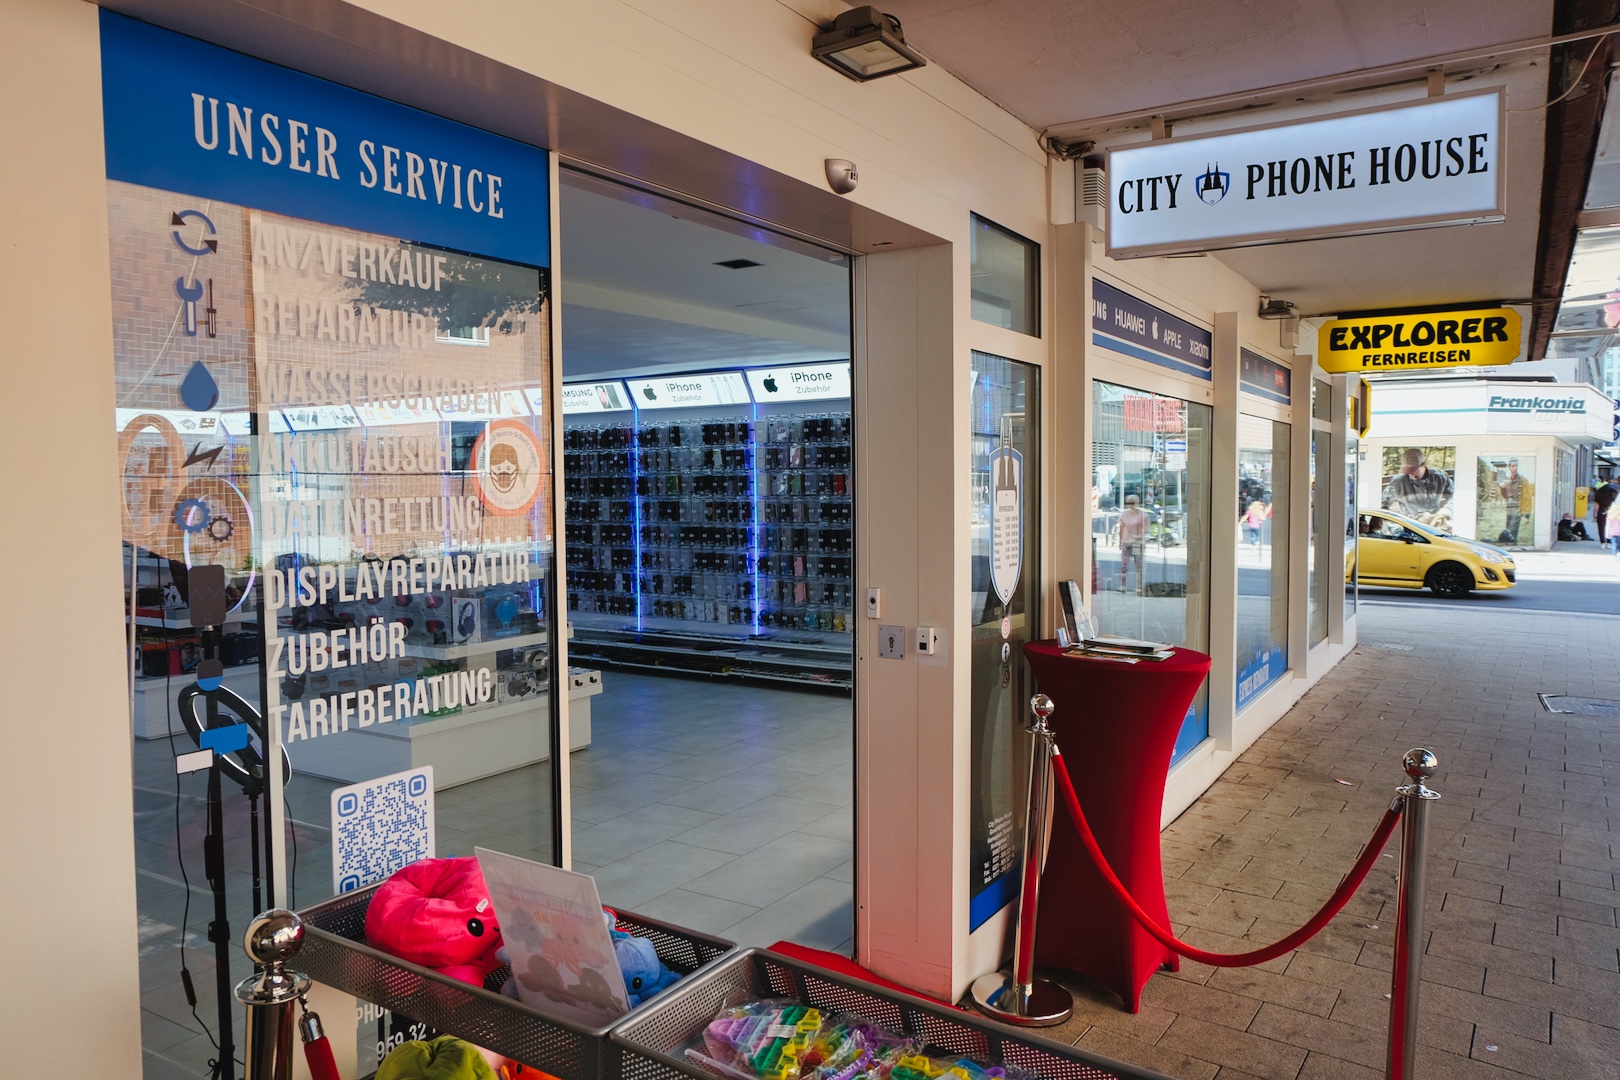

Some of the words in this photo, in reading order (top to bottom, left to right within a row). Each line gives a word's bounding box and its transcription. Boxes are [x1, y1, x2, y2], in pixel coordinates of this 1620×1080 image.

[191, 92, 341, 180] UNSER
[359, 139, 505, 219] SERVICE
[1118, 173, 1183, 215] CITY
[1246, 151, 1356, 200] PHONE
[1368, 133, 1489, 186] HOUSE
[252, 223, 447, 292] AN/VERKAUF
[256, 293, 428, 349] REPARATUR
[1114, 307, 1146, 336] HUAWEI
[1163, 328, 1182, 350] APPLE
[1329, 316, 1509, 352] EXPLORER
[790, 371, 833, 383] iPhone
[1362, 349, 1471, 367] FERNREISEN
[258, 362, 502, 415] WASSERSCHADEN
[562, 388, 593, 399] MSUNG
[665, 382, 702, 393] iPhone
[672, 394, 702, 403] Zubehör
[796, 385, 831, 394] Zubehör
[1489, 395, 1586, 410] Frankonia
[260, 431, 450, 473] AKKUTAUSCH
[263, 496, 481, 541] DATENRETTUNG
[267, 551, 530, 610] DISPLAYREPARATUR
[268, 617, 406, 679] ZUBEHÖR
[270, 667, 492, 747] TARIFBERATUNG
